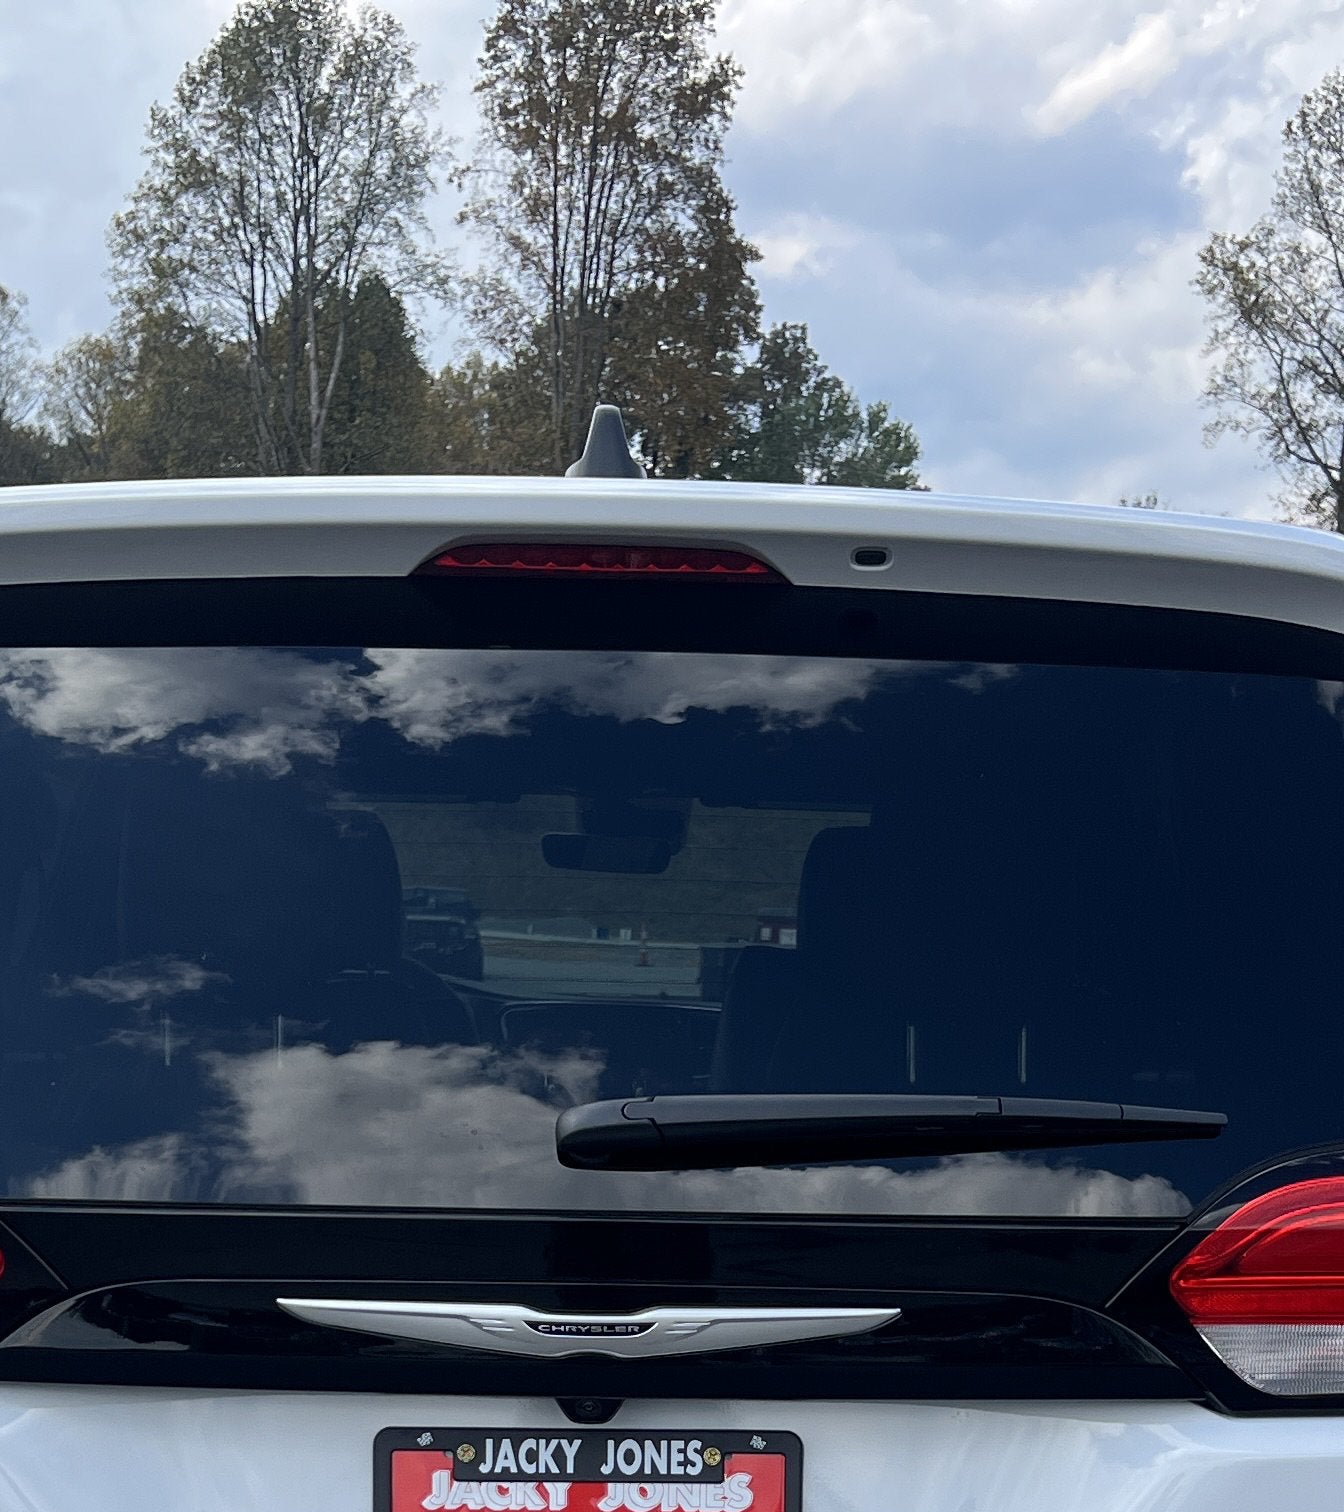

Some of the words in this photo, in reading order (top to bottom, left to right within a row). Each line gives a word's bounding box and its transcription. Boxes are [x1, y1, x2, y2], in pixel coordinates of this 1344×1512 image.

[538, 1324, 640, 1333] CHRYSLER
[479, 1438, 582, 1475] JACKY
[600, 1439, 704, 1476] JONES
[422, 1470, 573, 1511] JACKY
